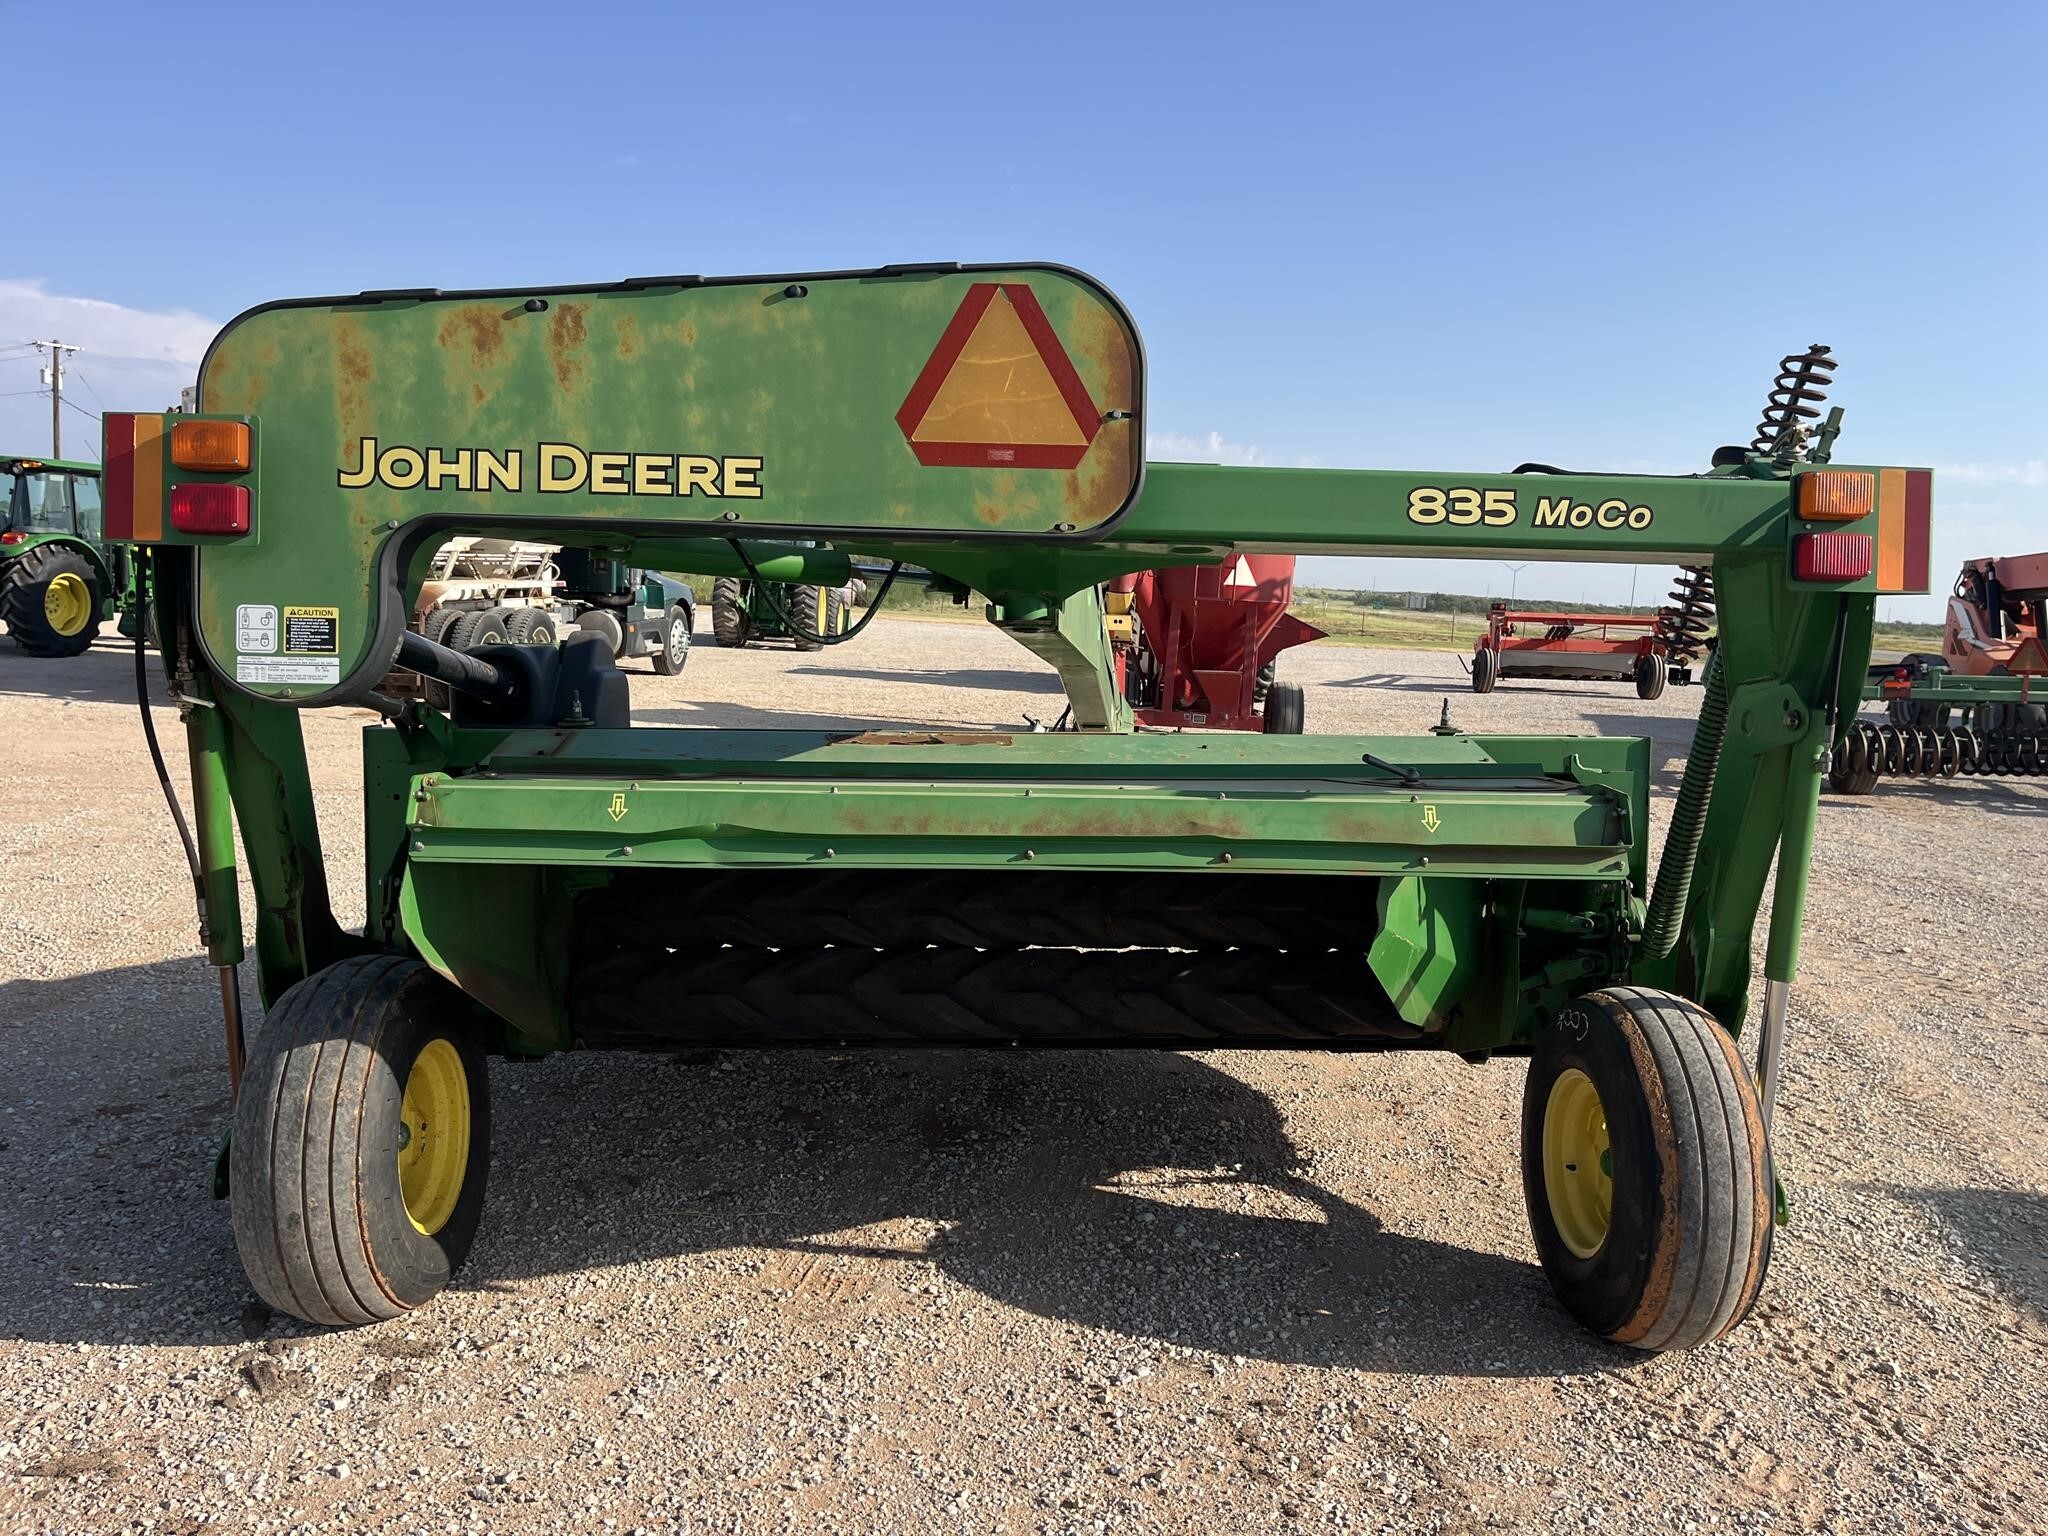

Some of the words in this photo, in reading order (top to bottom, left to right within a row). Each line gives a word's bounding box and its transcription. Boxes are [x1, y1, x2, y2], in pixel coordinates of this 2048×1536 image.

[338, 437, 522, 492] JOHN
[537, 442, 763, 498] DEERE
[1408, 487, 1518, 527] 835
[1531, 496, 1654, 530] MoCo
[296, 609, 334, 617] CAUTION
